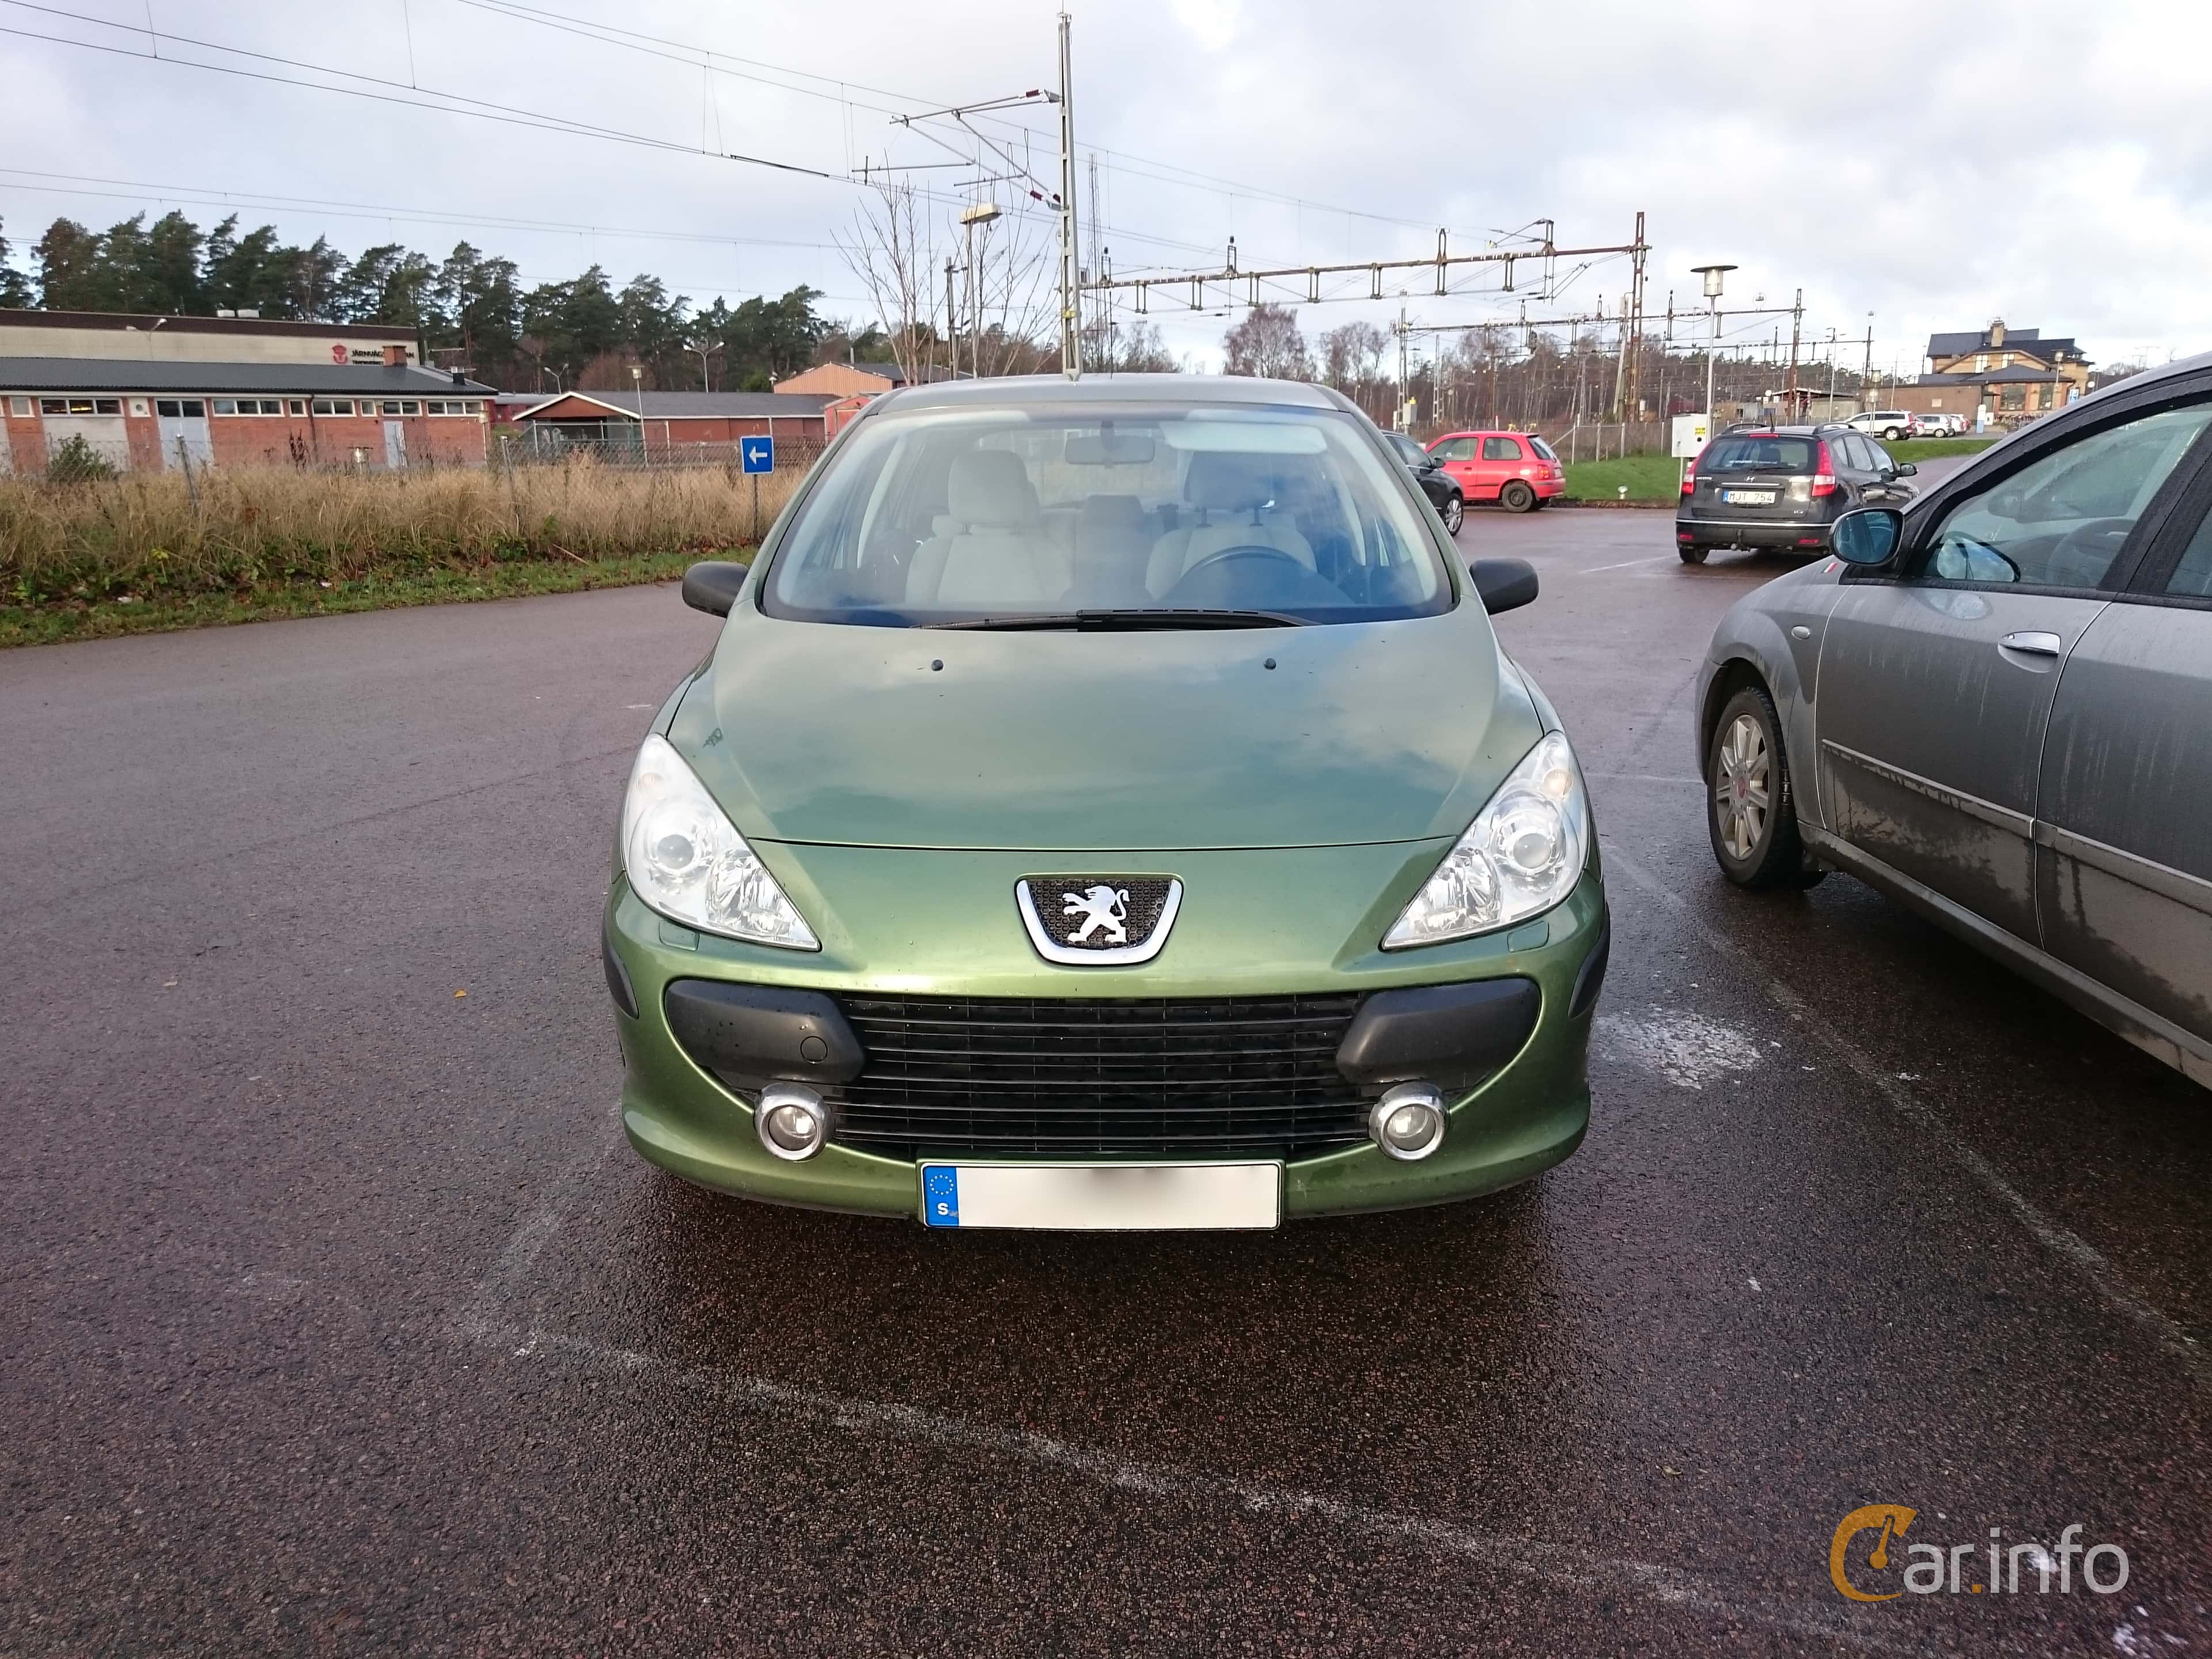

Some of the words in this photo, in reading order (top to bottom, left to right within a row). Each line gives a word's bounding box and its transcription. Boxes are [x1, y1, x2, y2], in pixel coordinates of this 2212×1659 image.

[1729, 493, 1747, 501] MJT
[1755, 493, 1772, 501] 754
[937, 1202, 949, 1215] S
